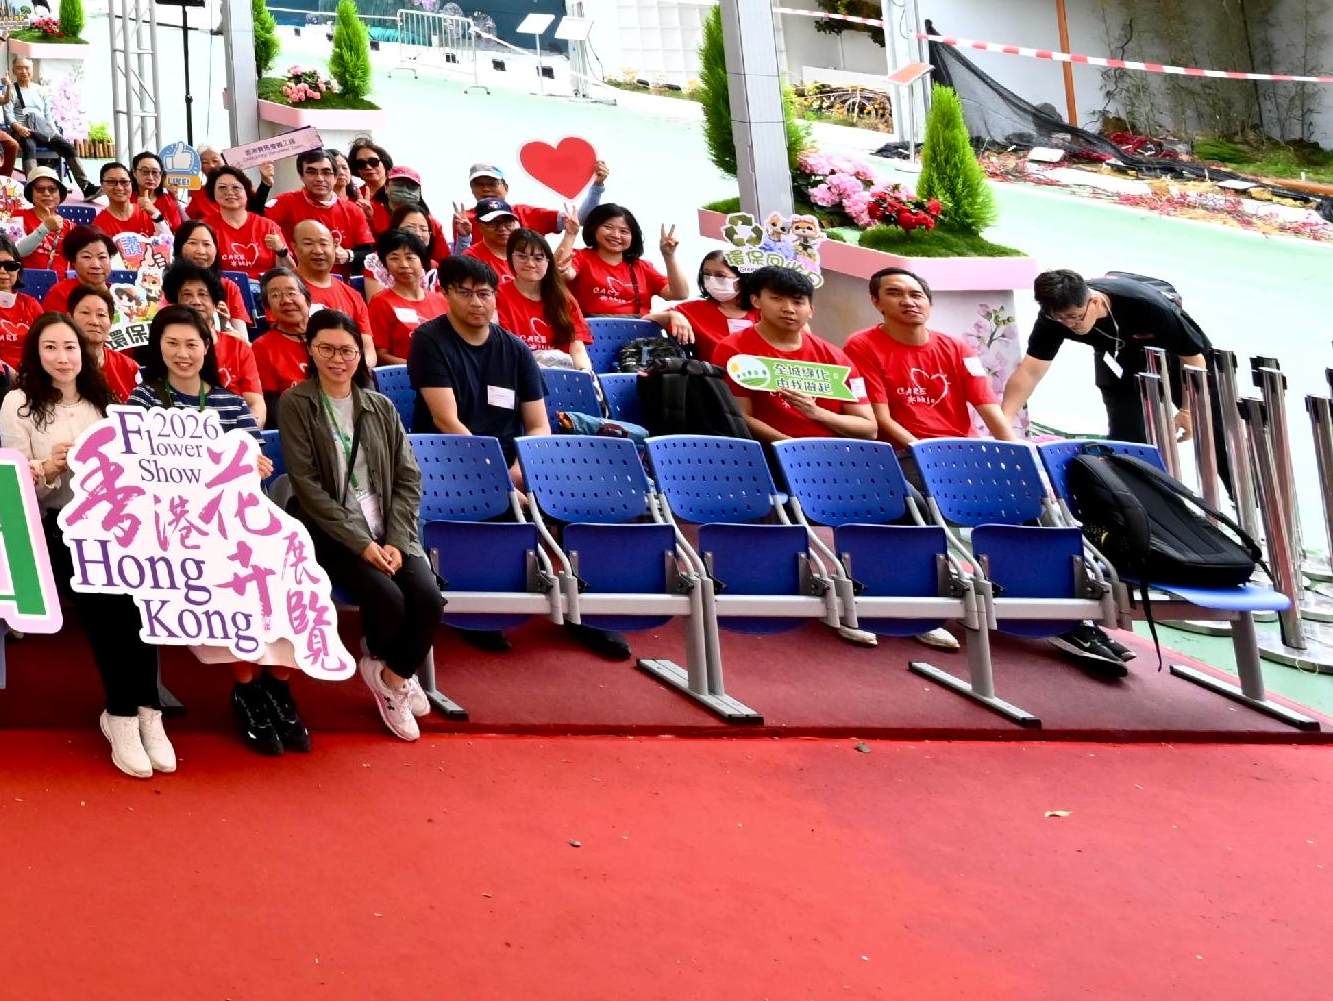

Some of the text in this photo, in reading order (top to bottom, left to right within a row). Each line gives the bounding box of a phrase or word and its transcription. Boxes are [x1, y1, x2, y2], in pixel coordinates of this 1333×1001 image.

[167, 176, 191, 186] LIKE!
[121, 235, 144, 255] 讚
[107, 324, 150, 348] 環保
[774, 363, 830, 381] 全城綠化
[776, 379, 832, 393] 由我做起
[897, 387, 927, 396] CARE
[113, 410, 203, 458] Flower
[154, 412, 219, 440] 2026
[139, 458, 202, 485] Show
[70, 538, 211, 606] Hong
[139, 598, 259, 653] Kong
